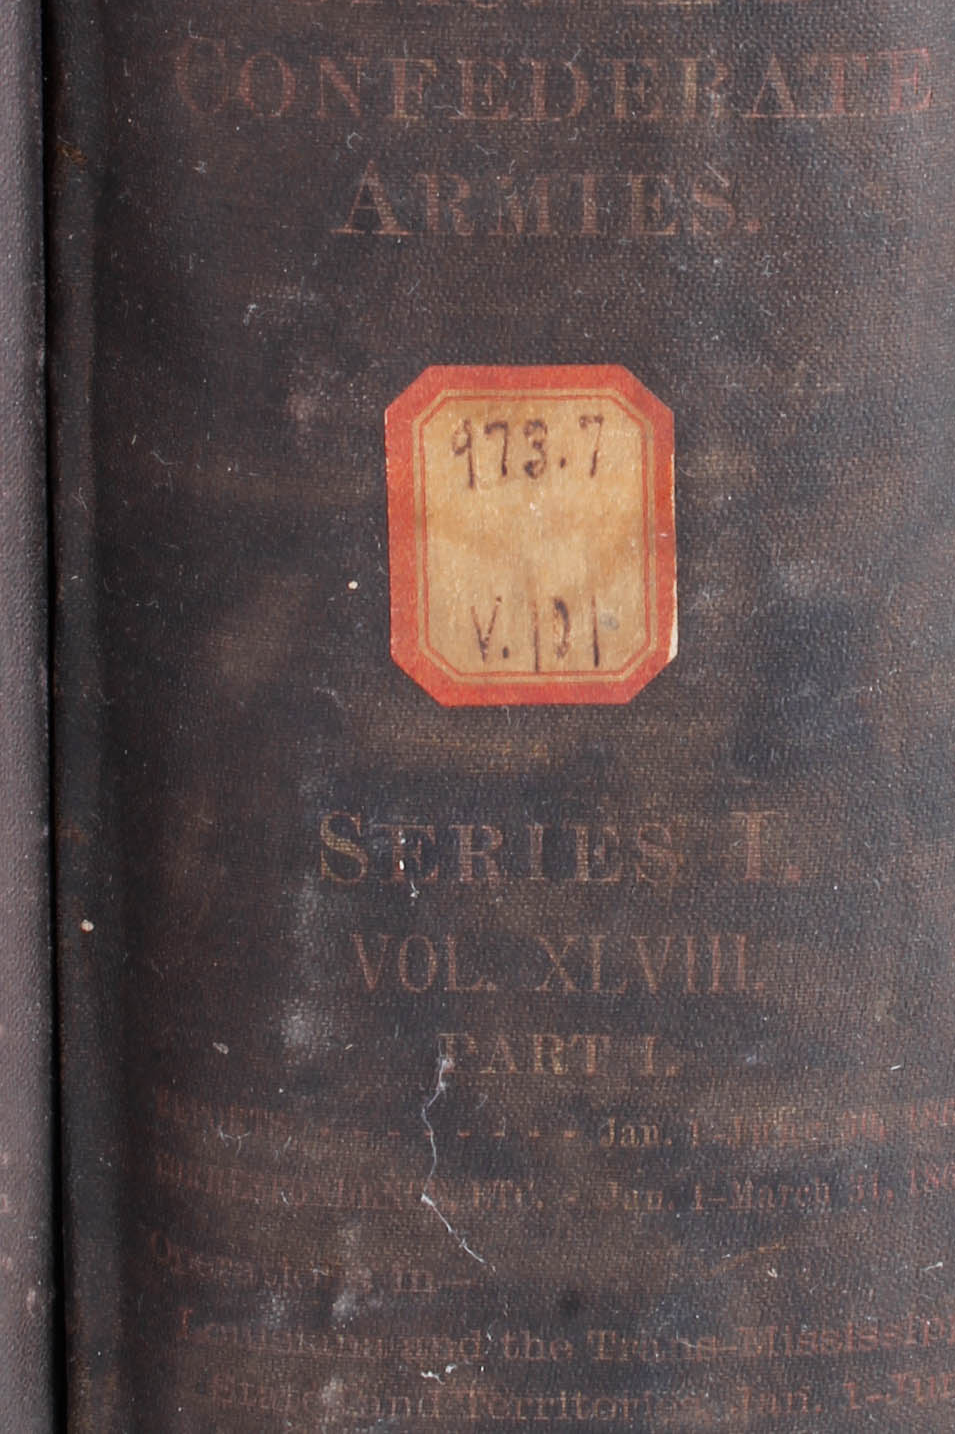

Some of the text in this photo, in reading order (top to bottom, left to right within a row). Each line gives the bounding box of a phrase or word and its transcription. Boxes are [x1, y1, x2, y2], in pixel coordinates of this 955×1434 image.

[172, 34, 940, 126] CONFEDERATE
[331, 159, 767, 242] ARMIES.
[451, 415, 606, 490] 973.7
[315, 807, 692, 889] SERIES
[350, 930, 498, 999] VOL.
[439, 1031, 612, 1079] PART
[499, 1328, 575, 1363] the
